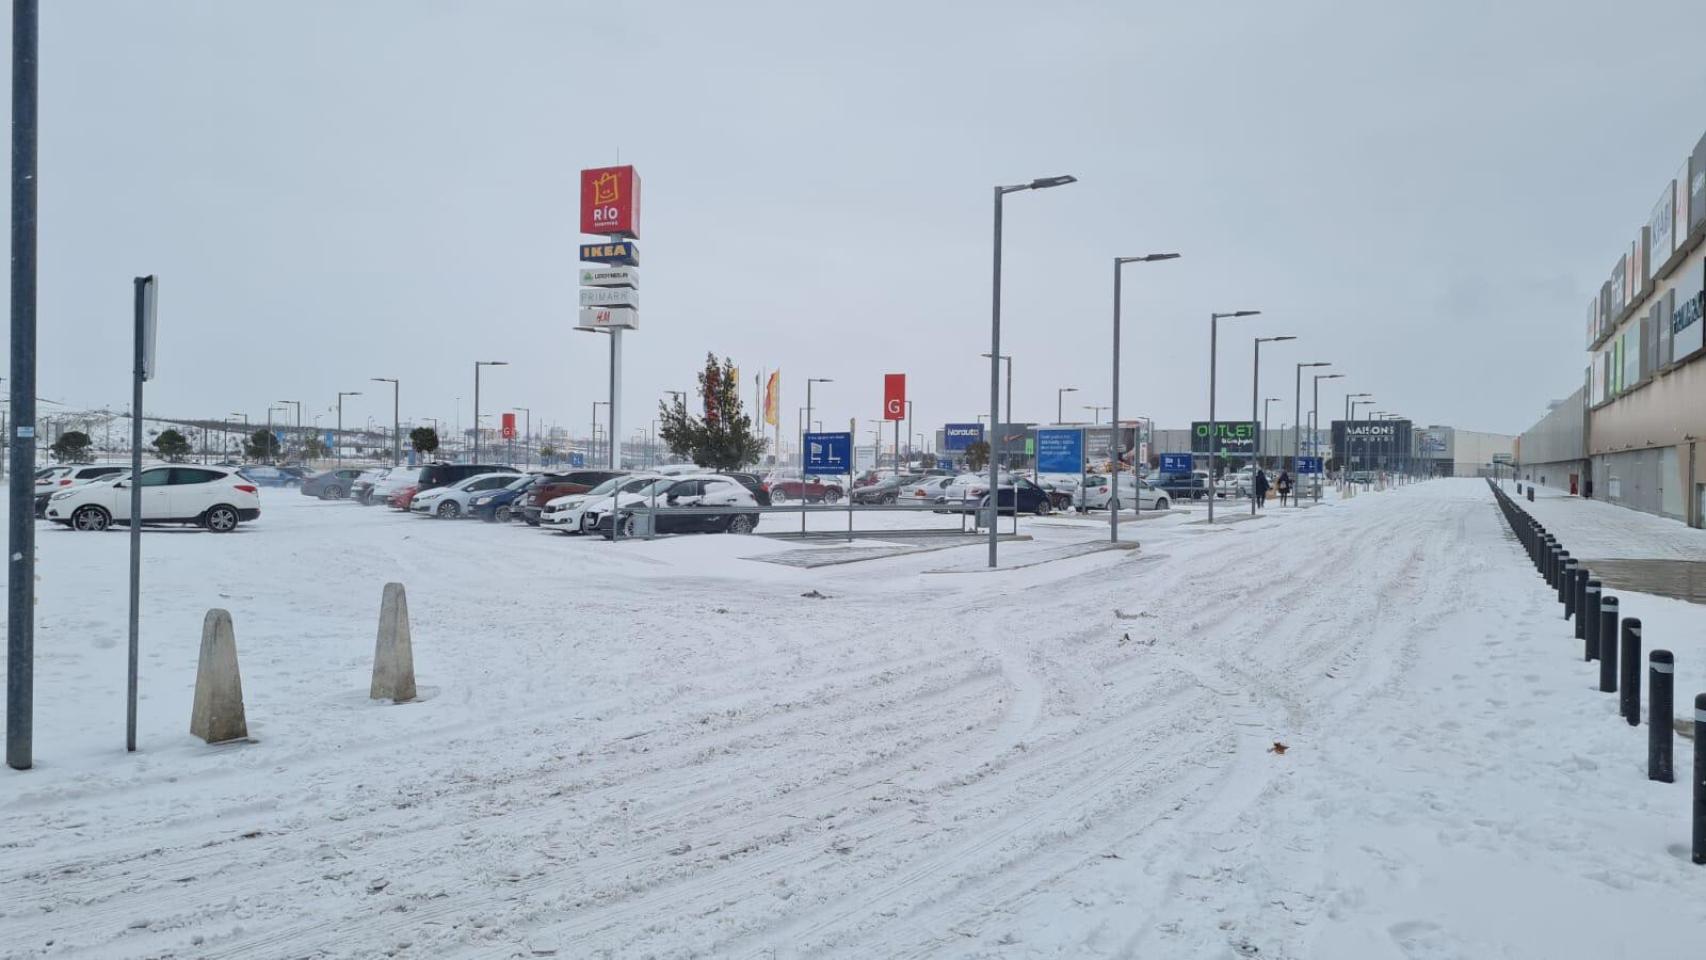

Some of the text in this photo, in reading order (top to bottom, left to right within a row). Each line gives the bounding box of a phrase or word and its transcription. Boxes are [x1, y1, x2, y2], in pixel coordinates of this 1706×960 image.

[593, 205, 618, 220] RÍO
[583, 244, 626, 257] IKEA
[581, 290, 628, 301] PRIMARK
[888, 399, 900, 413] G
[947, 427, 979, 436] Norauto
[1196, 424, 1253, 437] OUTLET
